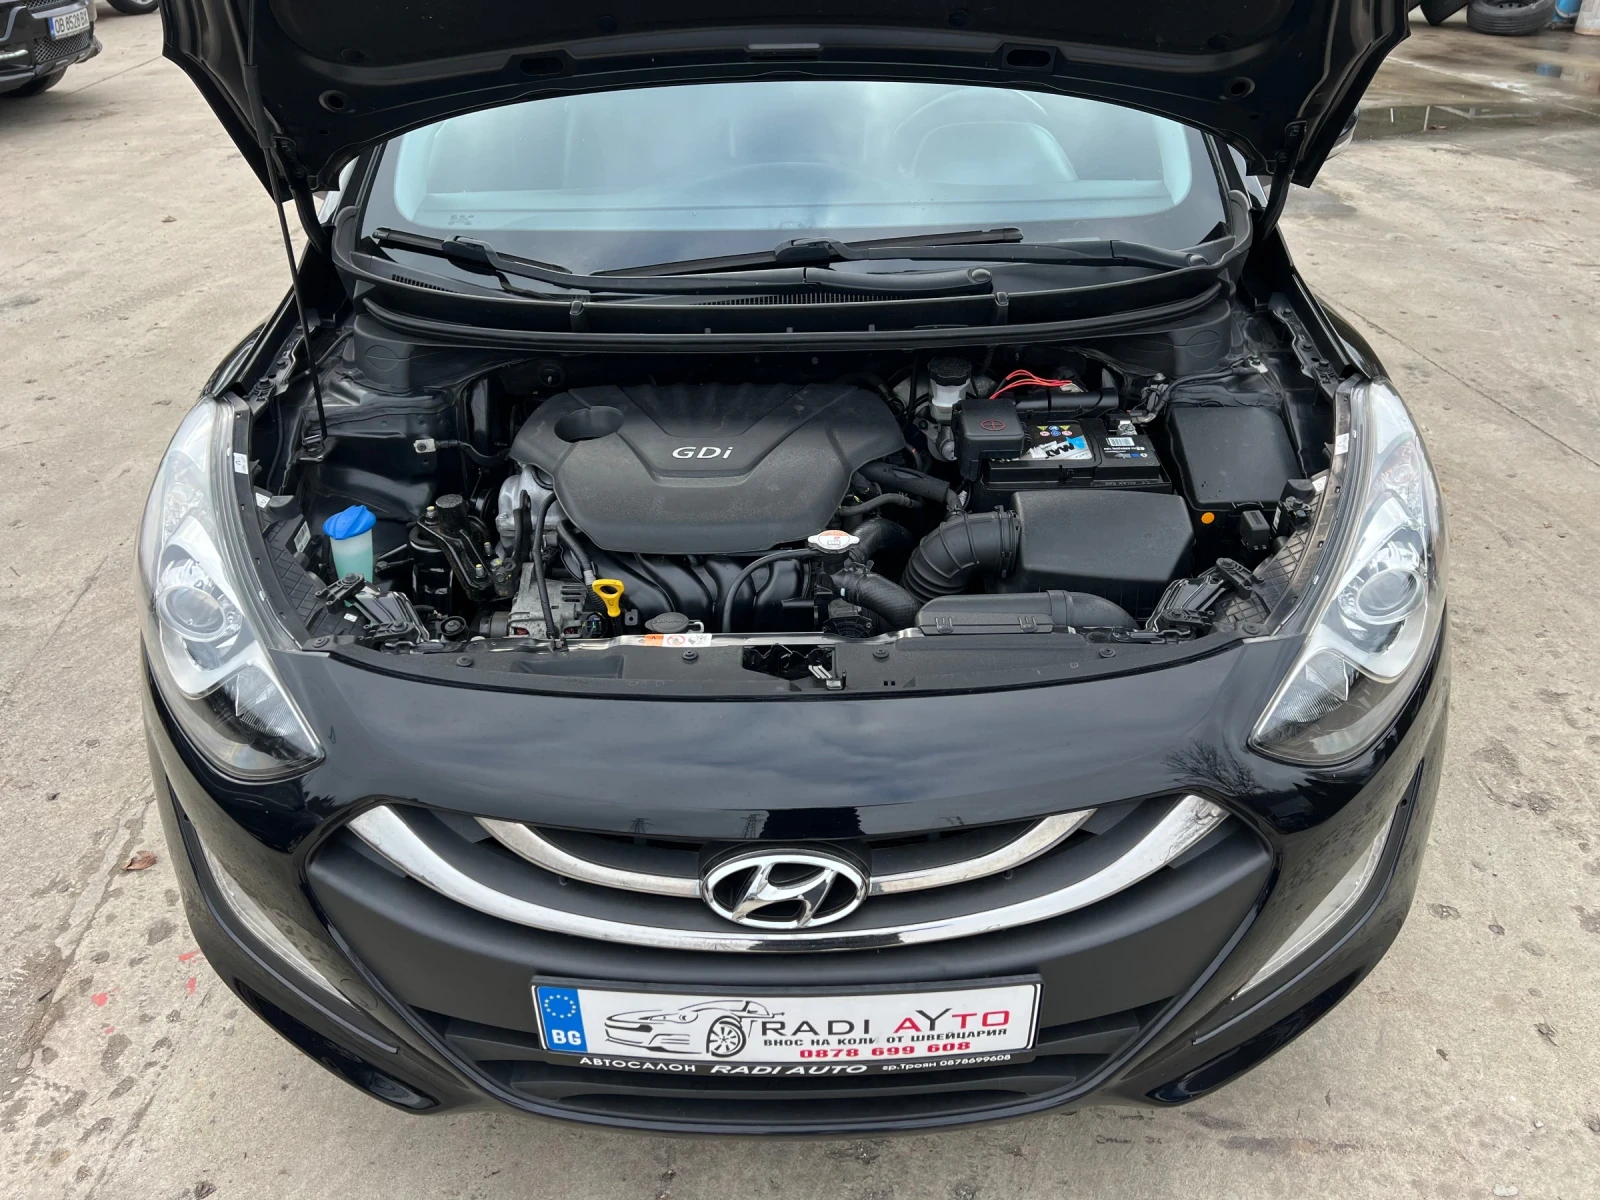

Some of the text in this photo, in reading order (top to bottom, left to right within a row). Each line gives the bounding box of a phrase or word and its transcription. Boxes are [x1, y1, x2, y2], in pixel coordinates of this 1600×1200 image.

[672, 446, 734, 459] GDi
[761, 1019, 870, 1036] RADI
[551, 1029, 582, 1046] BG
[763, 1038, 804, 1047] ВНОС
[810, 1038, 831, 1046] НА
[886, 1035, 905, 1044] ОТ
[910, 1028, 1008, 1043] ШВЕЙЦАРИЯ
[799, 1041, 971, 1059] 0878 699 608
[579, 1056, 697, 1073] АВТОСАЛОН
[939, 1054, 1012, 1067] 0878699608
[710, 1064, 868, 1075] RADI AUTO
